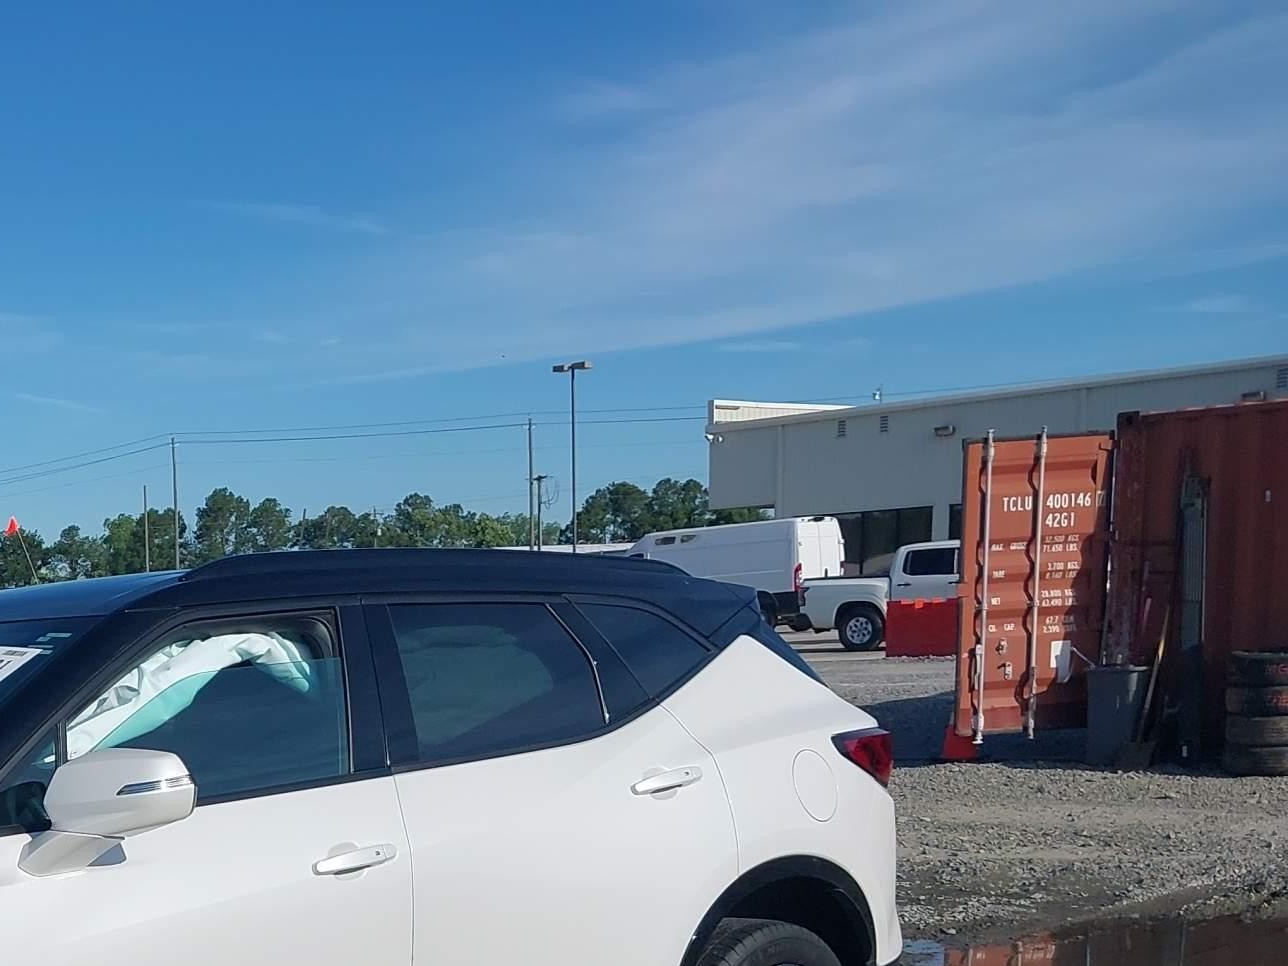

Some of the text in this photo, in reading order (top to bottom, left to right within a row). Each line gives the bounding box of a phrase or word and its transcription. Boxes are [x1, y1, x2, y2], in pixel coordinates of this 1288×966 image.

[1002, 495, 1032, 512] TCLU
[1046, 492, 1092, 509] 400146
[1045, 512, 1075, 528] 42G1
